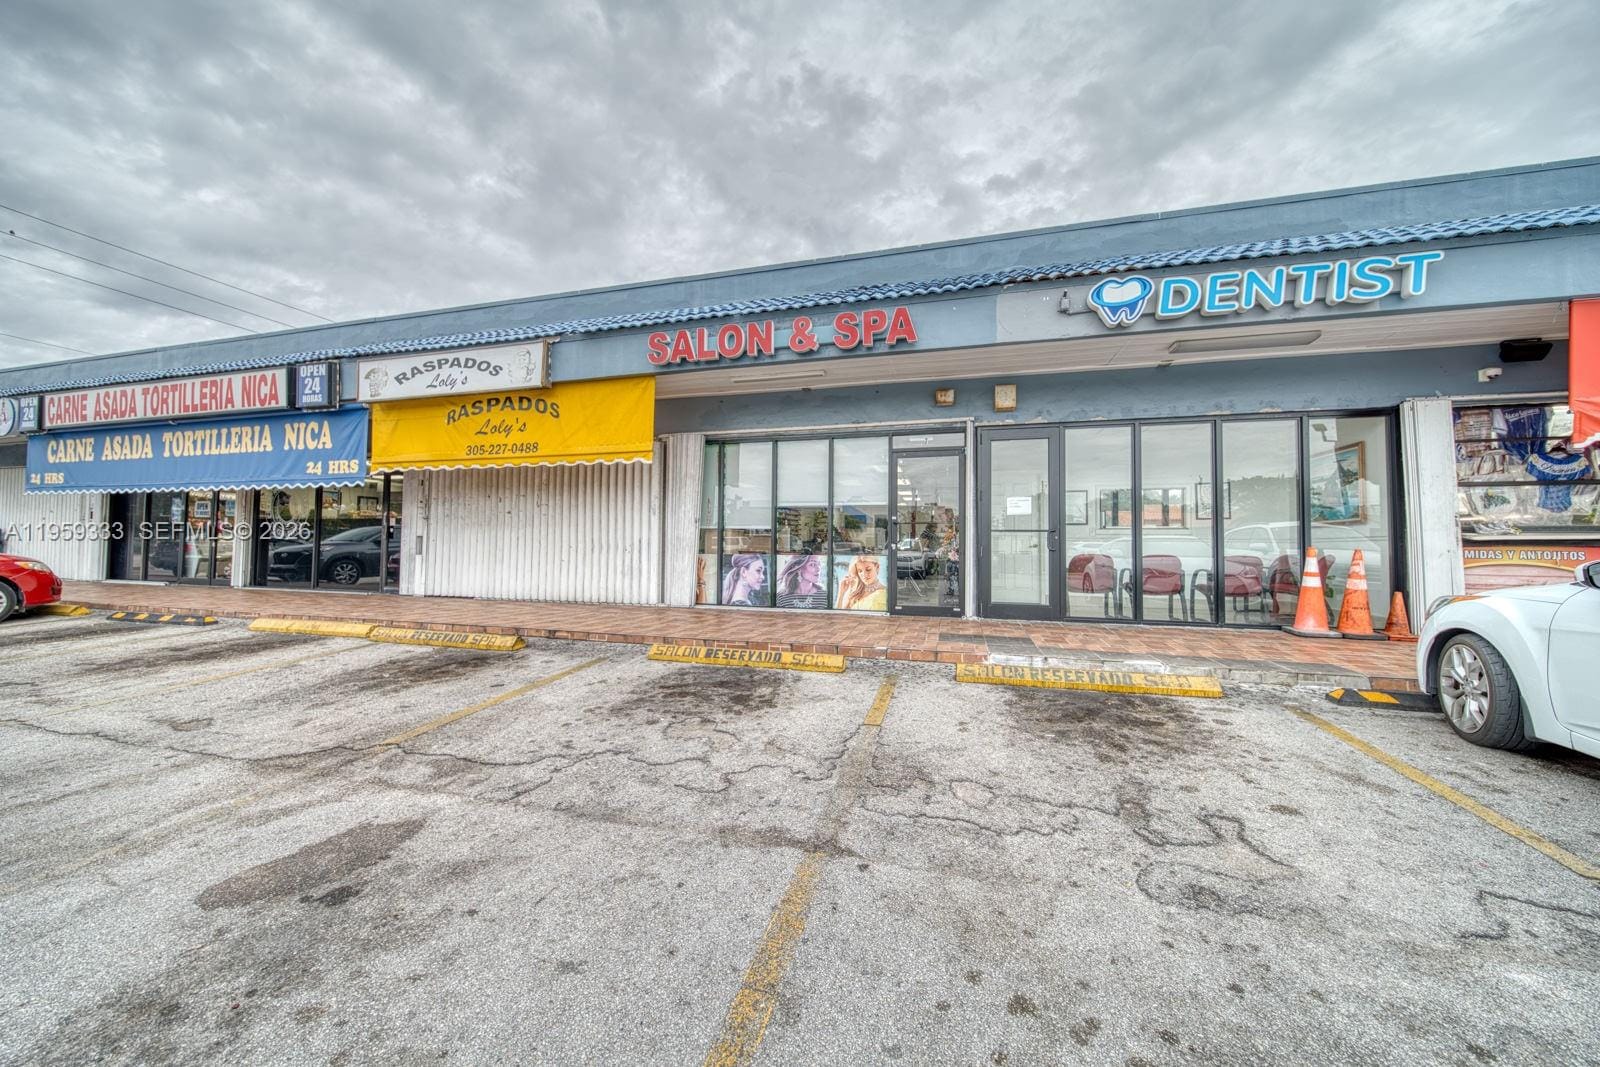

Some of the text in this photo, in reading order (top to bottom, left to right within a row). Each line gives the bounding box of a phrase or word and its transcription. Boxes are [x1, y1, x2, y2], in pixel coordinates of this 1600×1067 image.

[1155, 250, 1445, 321] DENTIST
[647, 306, 919, 366] SALON & SPA
[300, 364, 326, 377] OPEN
[394, 357, 504, 385] RASPADOS
[304, 377, 320, 394] 24
[425, 371, 468, 390] Loly's
[48, 394, 88, 424] CARNE
[94, 388, 137, 421] ASADA
[142, 377, 235, 416] TORTILLERIA
[241, 372, 280, 408] NICA
[23, 407, 34, 420] 24
[446, 395, 560, 426] RASPADOS
[475, 418, 527, 438] Loly's
[47, 420, 332, 463] CARNE ASADA TORTILLERIA NICA
[465, 442, 539, 457] 305-227-0488
[306, 459, 359, 475] 24 HRS
[31, 473, 64, 485] 24 HRS
[1464, 550, 1586, 561] MIDAS Y ANTOJITOS
[653, 645, 701, 657] SALON
[1030, 667, 1134, 686] RESERVADO
